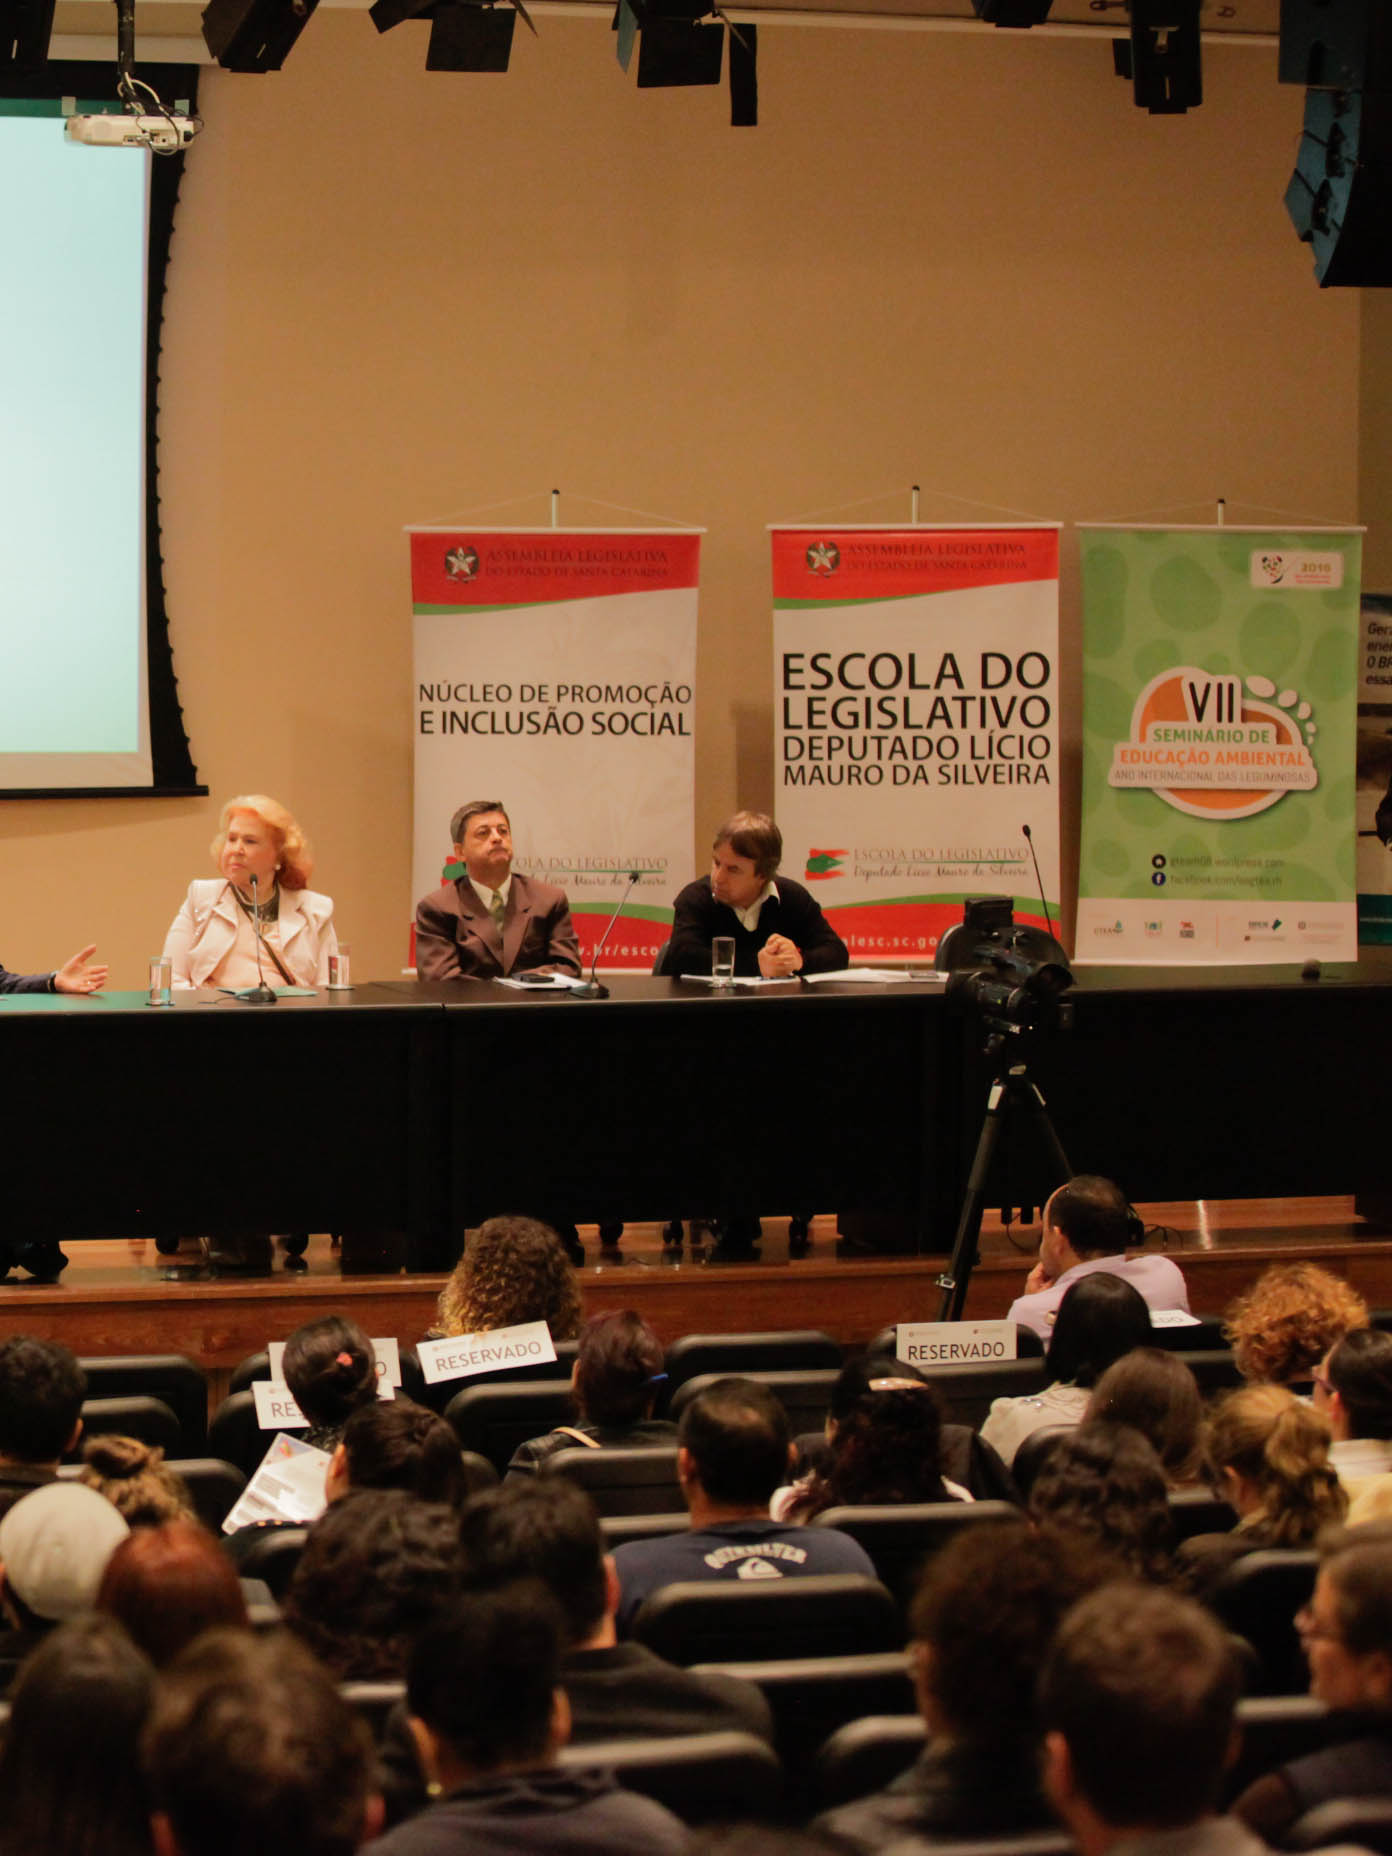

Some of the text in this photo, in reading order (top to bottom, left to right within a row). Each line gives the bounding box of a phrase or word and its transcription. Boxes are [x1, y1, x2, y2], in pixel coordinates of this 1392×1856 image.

[783, 652, 1051, 691] ESCOLA DO
[419, 680, 692, 709] NÚCLEO DE PROMOÇÃO
[1189, 682, 1234, 723] VII
[420, 706, 691, 736] E INCLUSÃO SOCIAL
[783, 695, 1051, 730] LEGISLATIVO
[784, 730, 1051, 761] DEPUTADO LÍCIO
[1153, 725, 1270, 743] SEMINÁRIO DE
[1120, 747, 1304, 768] EDUCAÇÃO AMBIENTAL
[784, 764, 1050, 786] MAURO DA SILVEIRA
[1115, 770, 1135, 780] ANO
[1138, 770, 1212, 781] INTERNACIONAL
[550, 856, 572, 869] DO
[578, 856, 668, 869] LEGISLATIVO
[854, 847, 1029, 859] ESCOLA DO LEGISLATIVO
[435, 1341, 542, 1371] RESERVADO
[908, 1341, 1005, 1360] RESERVADO
